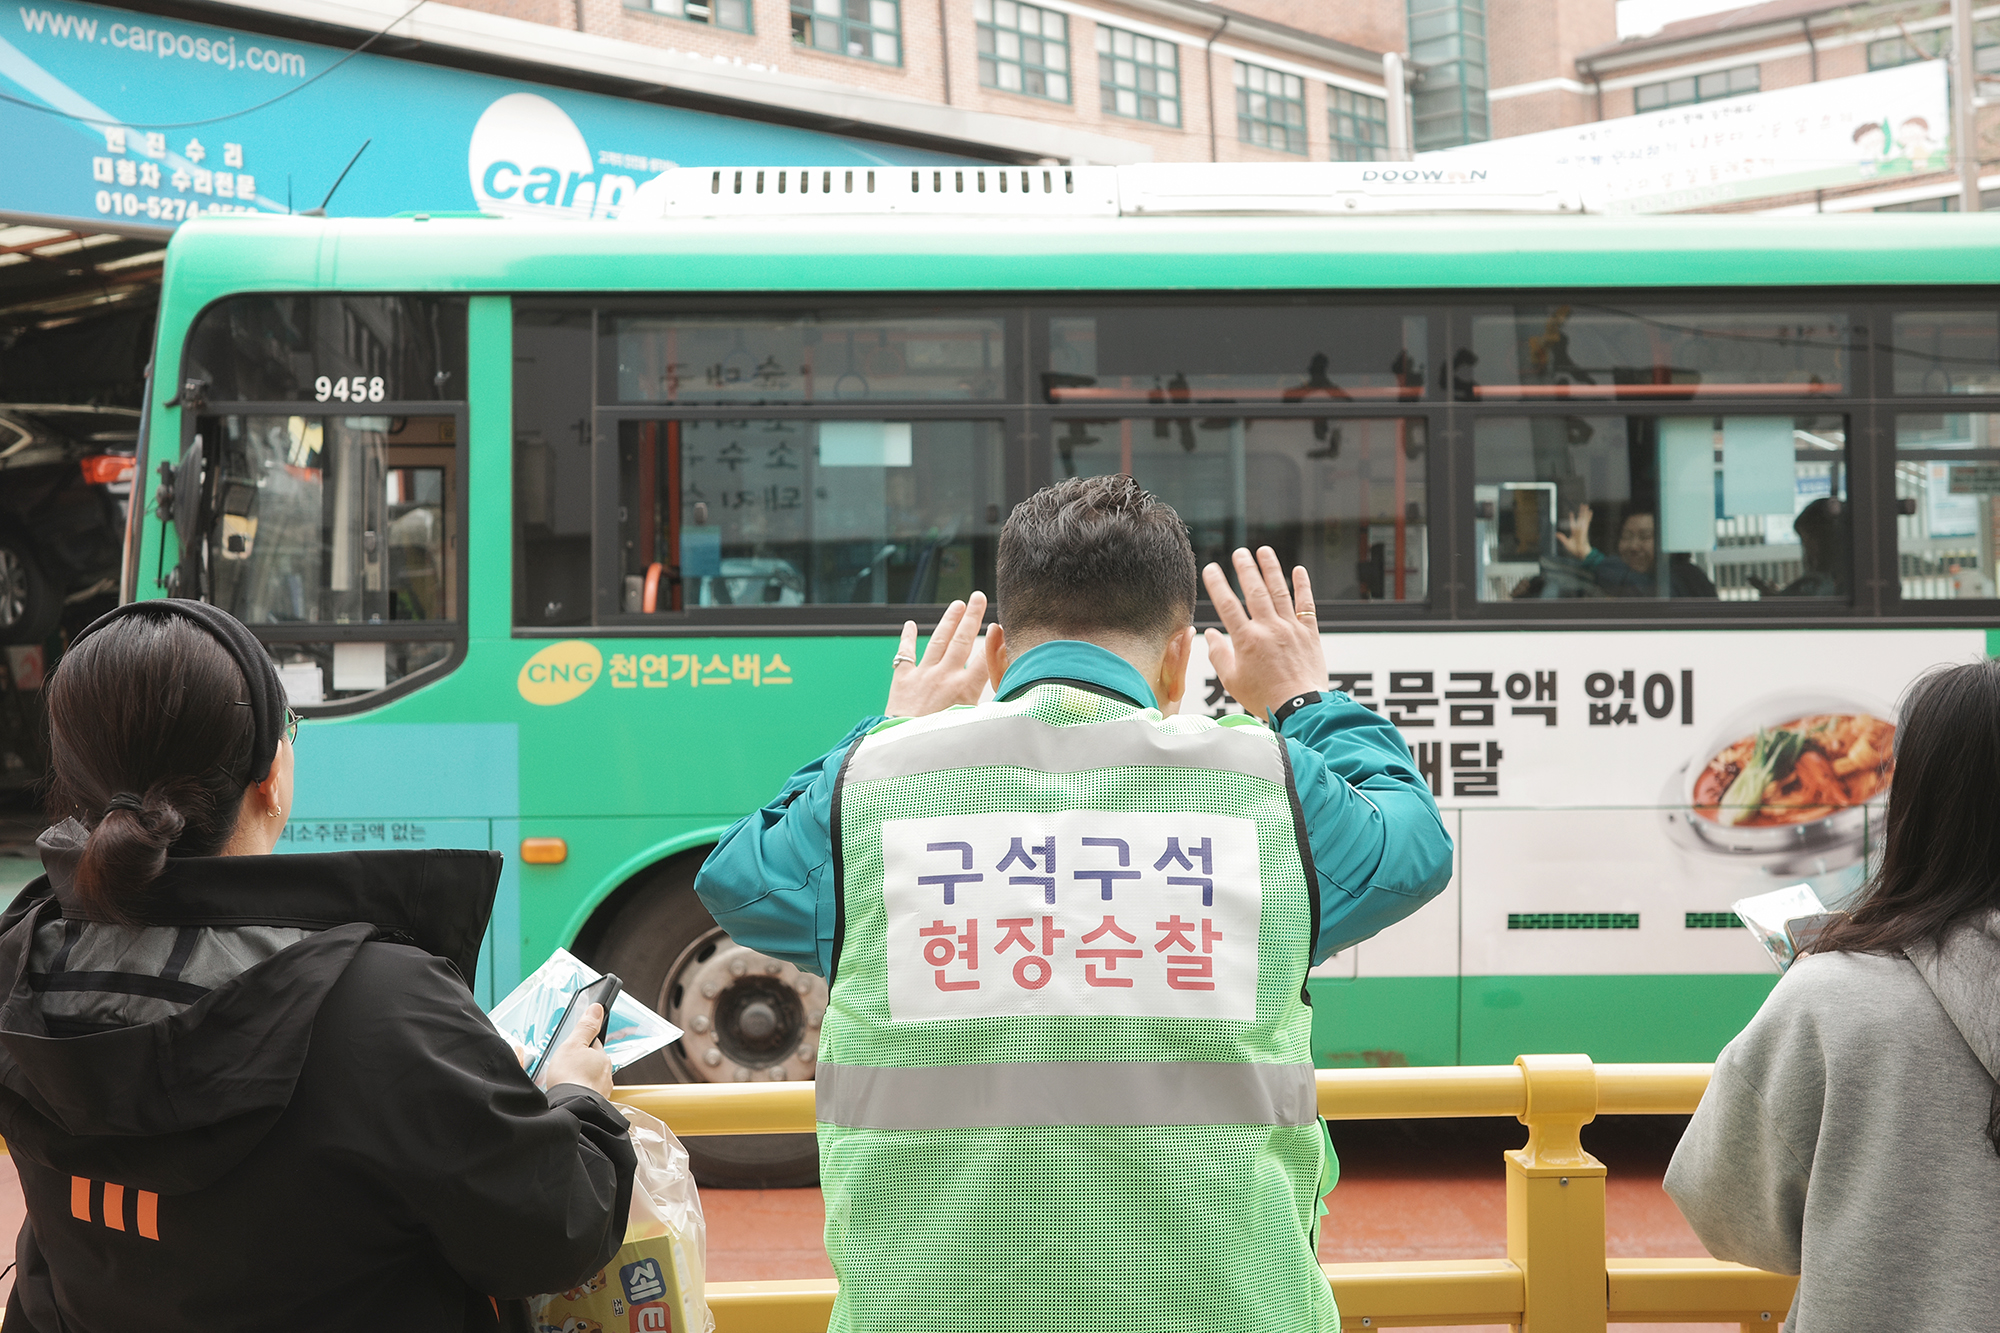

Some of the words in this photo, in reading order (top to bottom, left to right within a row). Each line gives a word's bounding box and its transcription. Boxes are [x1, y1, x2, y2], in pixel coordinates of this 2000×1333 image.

[19, 6, 306, 78] www.carposcj.com
[314, 375, 385, 403] 9458
[527, 663, 594, 683] CNG
[608, 653, 793, 688] 천연가스버스
[1584, 669, 1695, 726] 없이
[917, 836, 1214, 907] 구석구석
[918, 914, 1224, 993] 현장순찰
